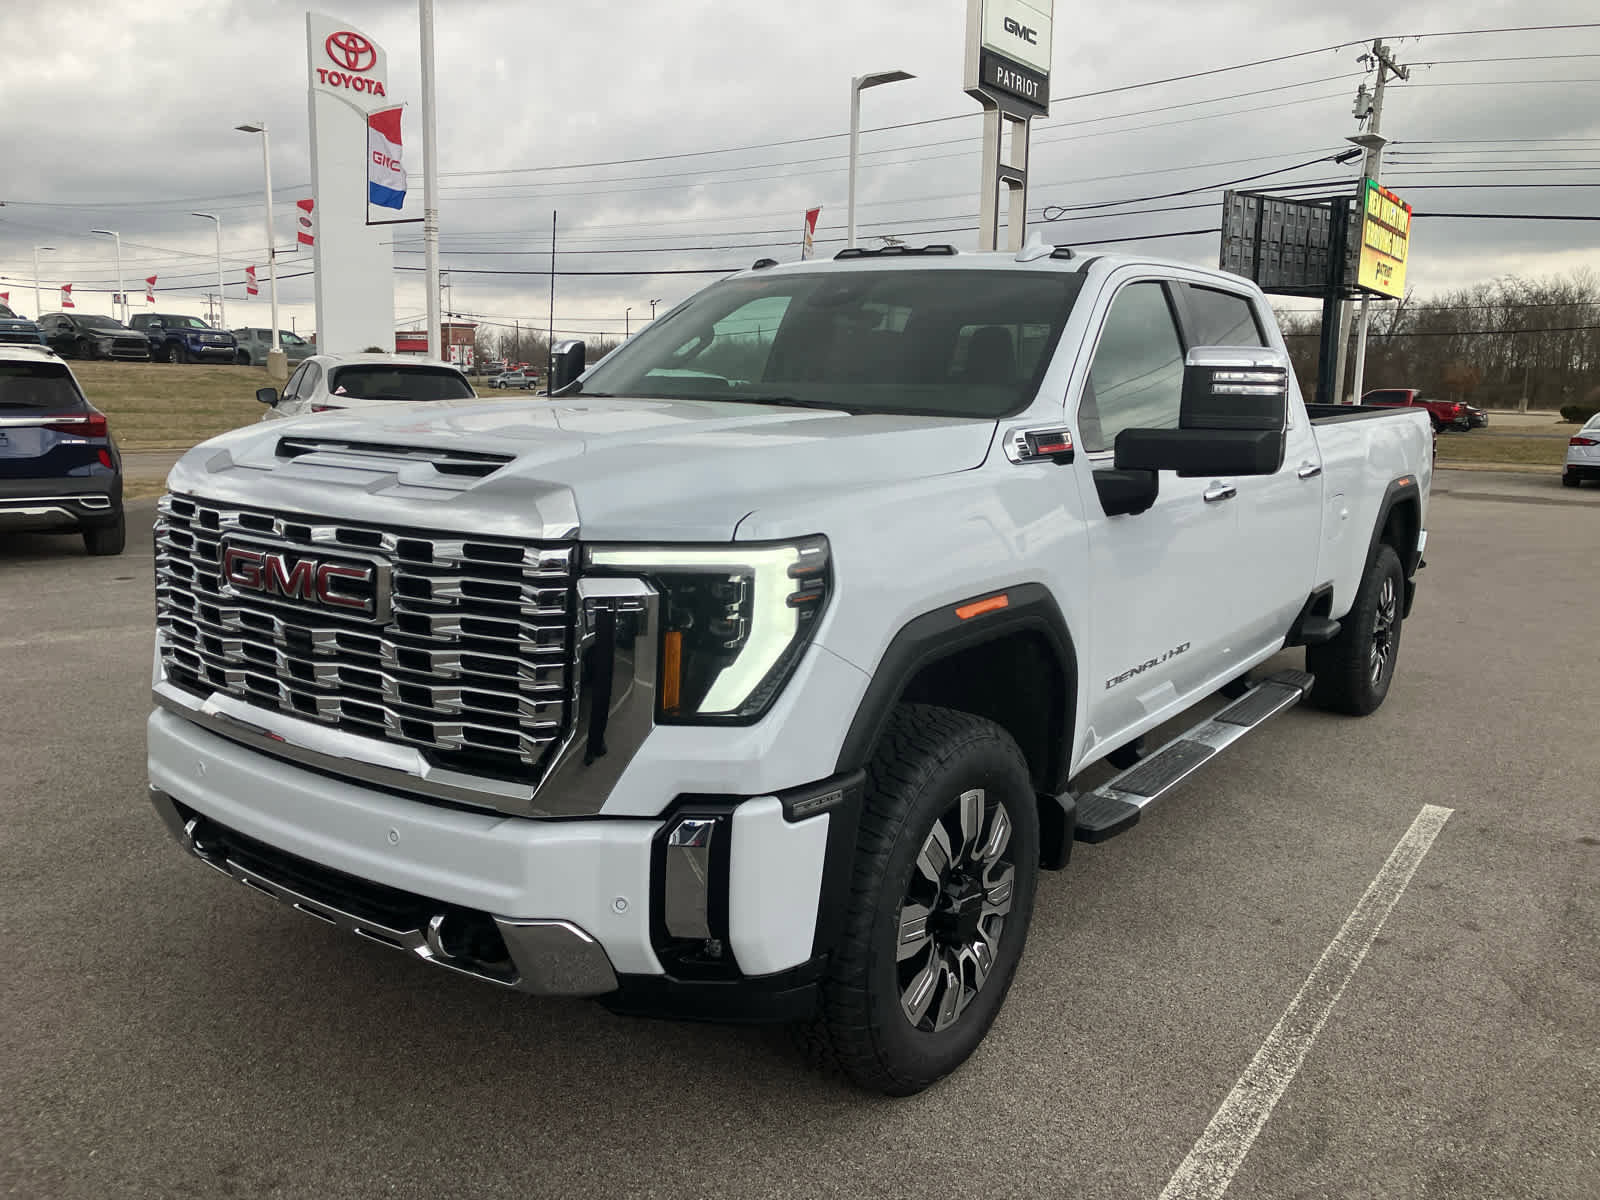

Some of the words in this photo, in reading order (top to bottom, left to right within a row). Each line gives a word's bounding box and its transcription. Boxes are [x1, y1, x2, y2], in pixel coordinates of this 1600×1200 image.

[1004, 16, 1037, 46] GMC
[316, 67, 386, 97] TOYOTA
[997, 66, 1039, 98] PATRIOT
[372, 150, 401, 172] GMC
[225, 547, 373, 612] GMC
[1105, 653, 1168, 690] DENALI
[1168, 641, 1191, 659] HD
